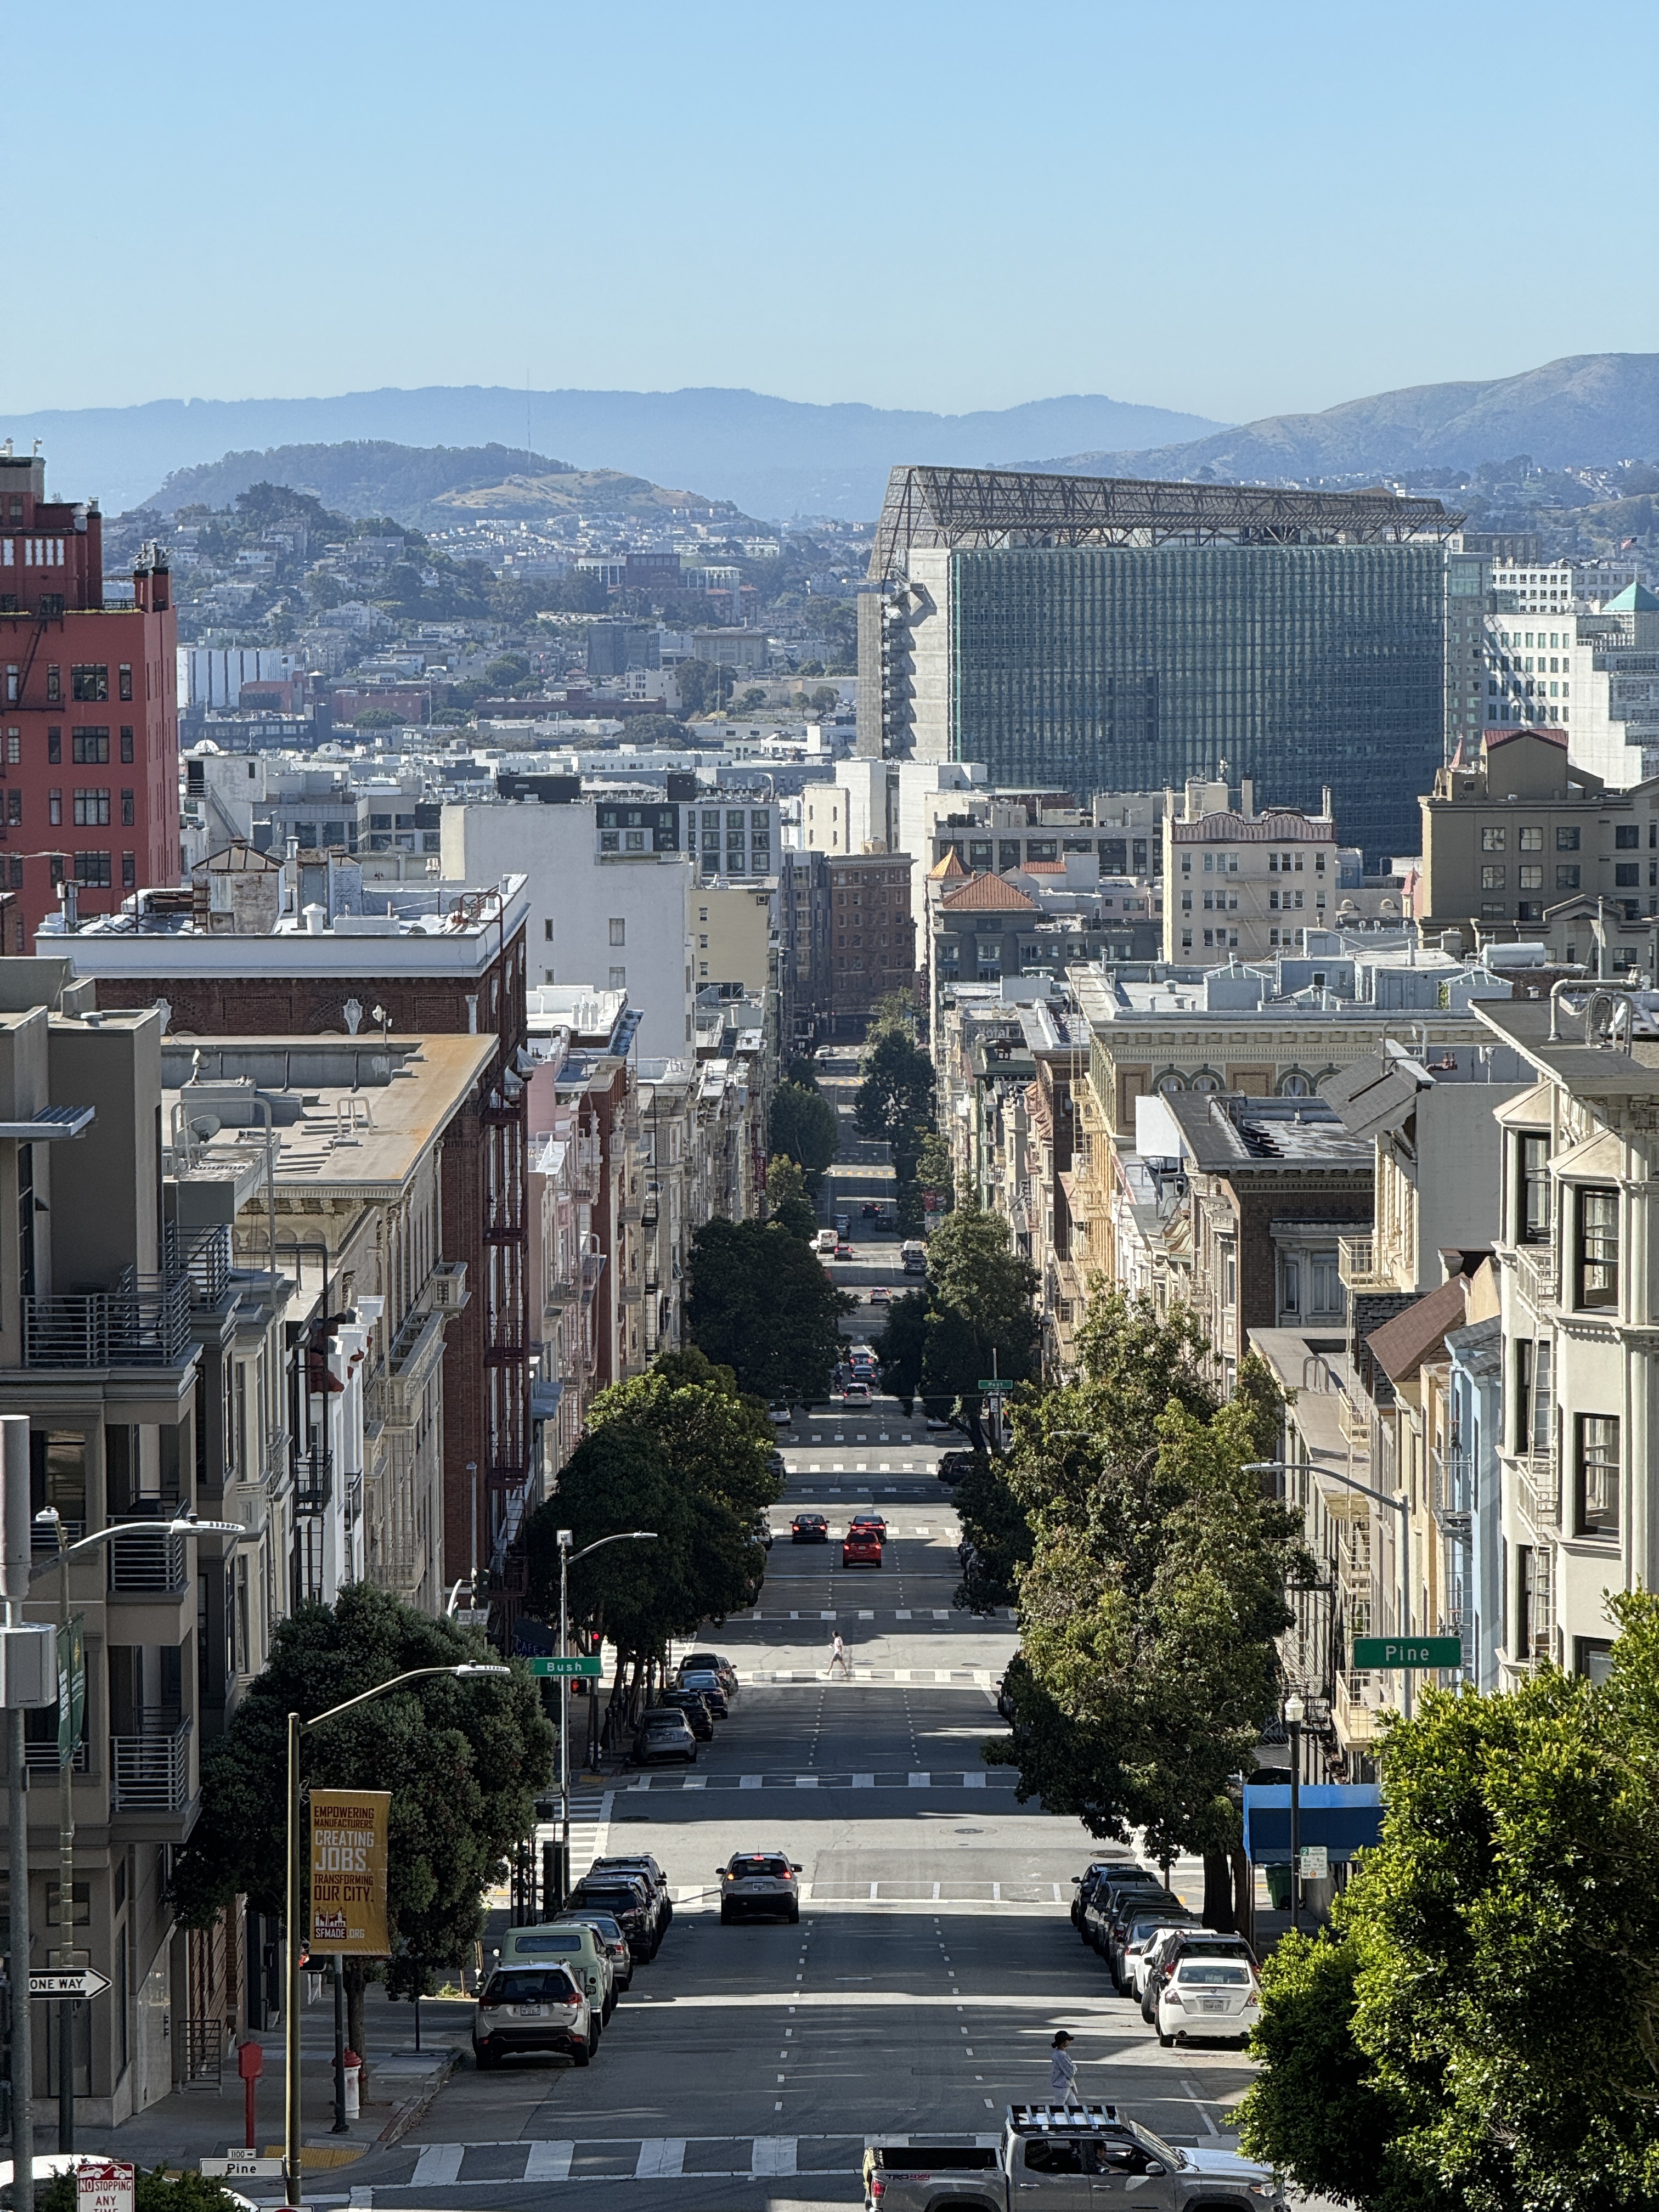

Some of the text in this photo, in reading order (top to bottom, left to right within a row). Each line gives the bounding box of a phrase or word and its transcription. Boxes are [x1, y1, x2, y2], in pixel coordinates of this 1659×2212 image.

[1386, 1645, 1429, 1661] Pine
[547, 1662, 582, 1672] Bush
[314, 1806, 374, 1819] EMPOWERING
[315, 1830, 374, 1847] CREATING
[315, 1847, 371, 1872] JOBS.
[314, 1874, 373, 1885] TRANSFORMING
[314, 1886, 374, 1902] OUR CITY.
[30, 1978, 83, 1989] ONE WAY
[227, 2163, 256, 2174] Pine
[80, 2179, 131, 2192] NO STOPPING
[95, 2196, 117, 2205] ANY
